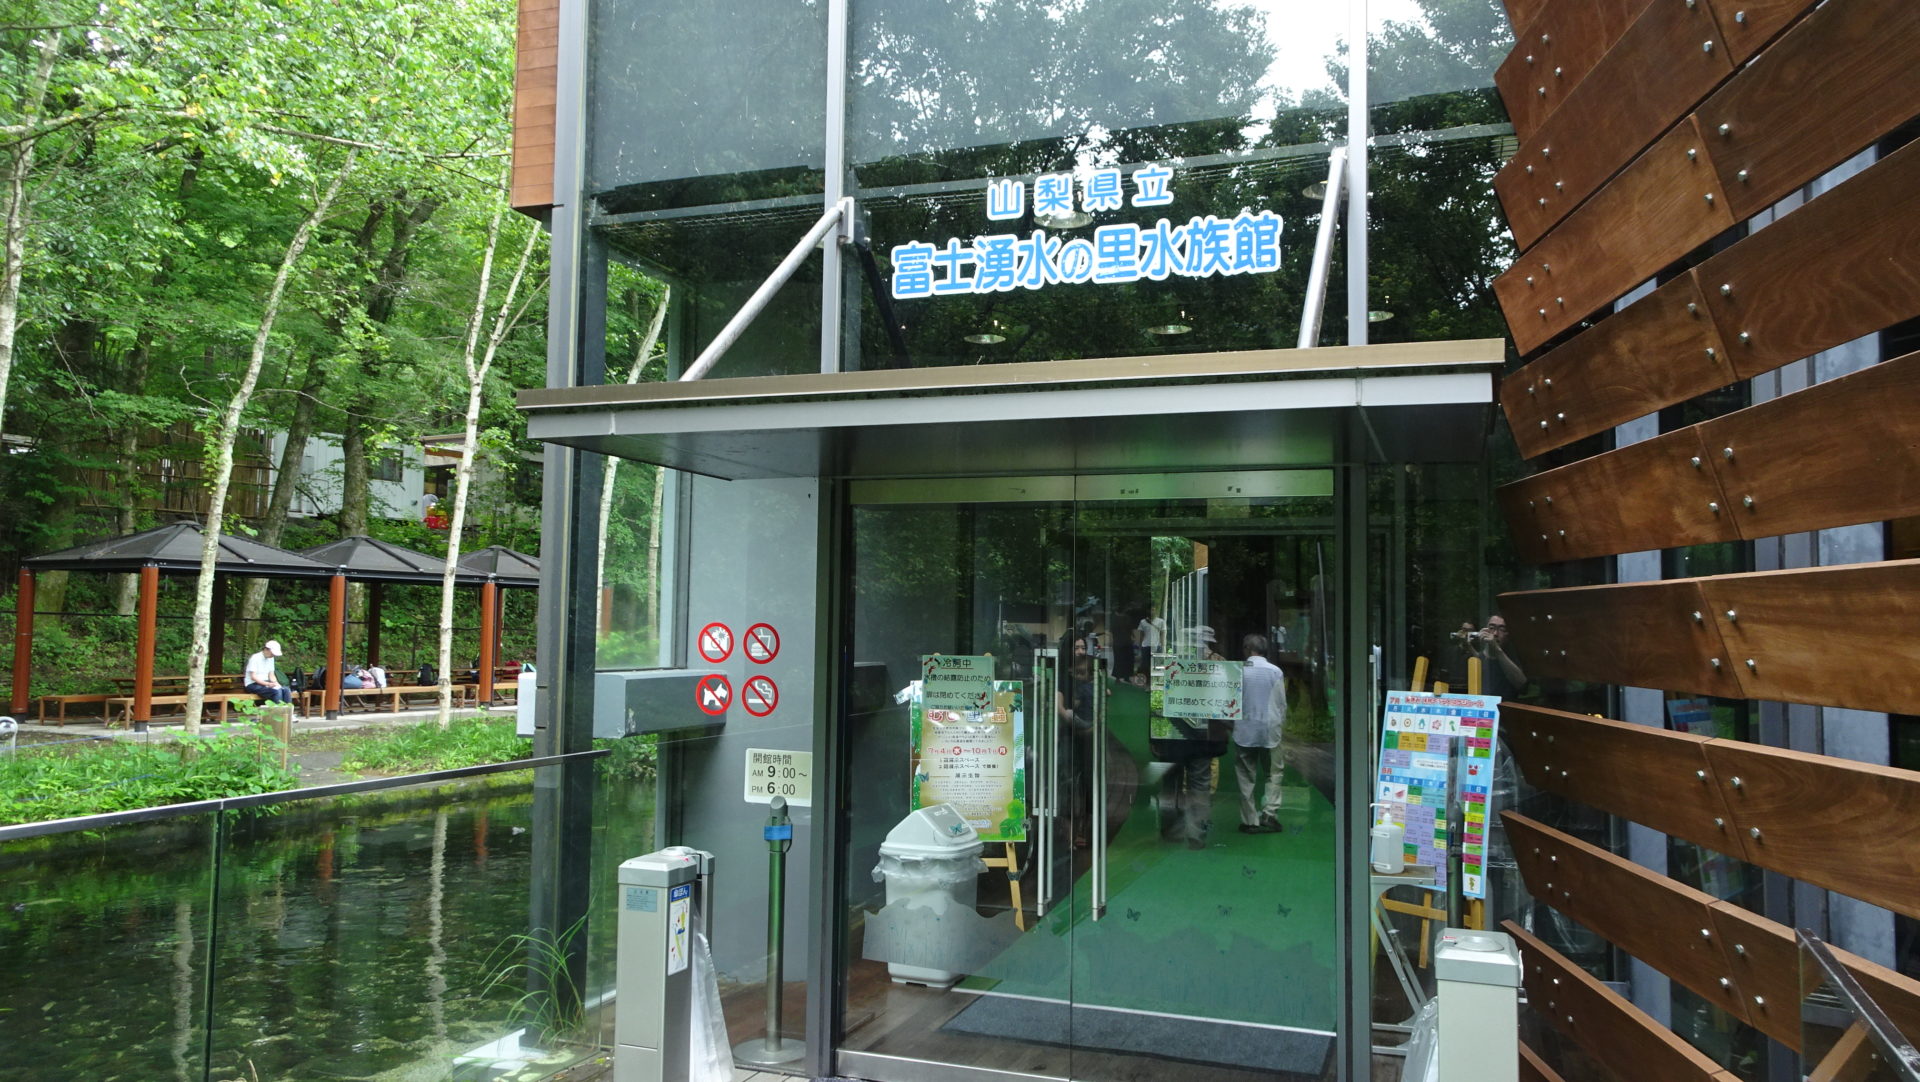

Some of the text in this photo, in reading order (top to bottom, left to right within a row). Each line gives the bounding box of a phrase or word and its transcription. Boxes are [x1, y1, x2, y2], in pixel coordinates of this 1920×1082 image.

[988, 165, 1173, 219] 山梨県立
[892, 211, 1283, 299] 富士湧水の里水族館
[753, 752, 792, 765] 開館時間
[752, 769, 764, 777] AM
[751, 781, 796, 795] PM 6:00
